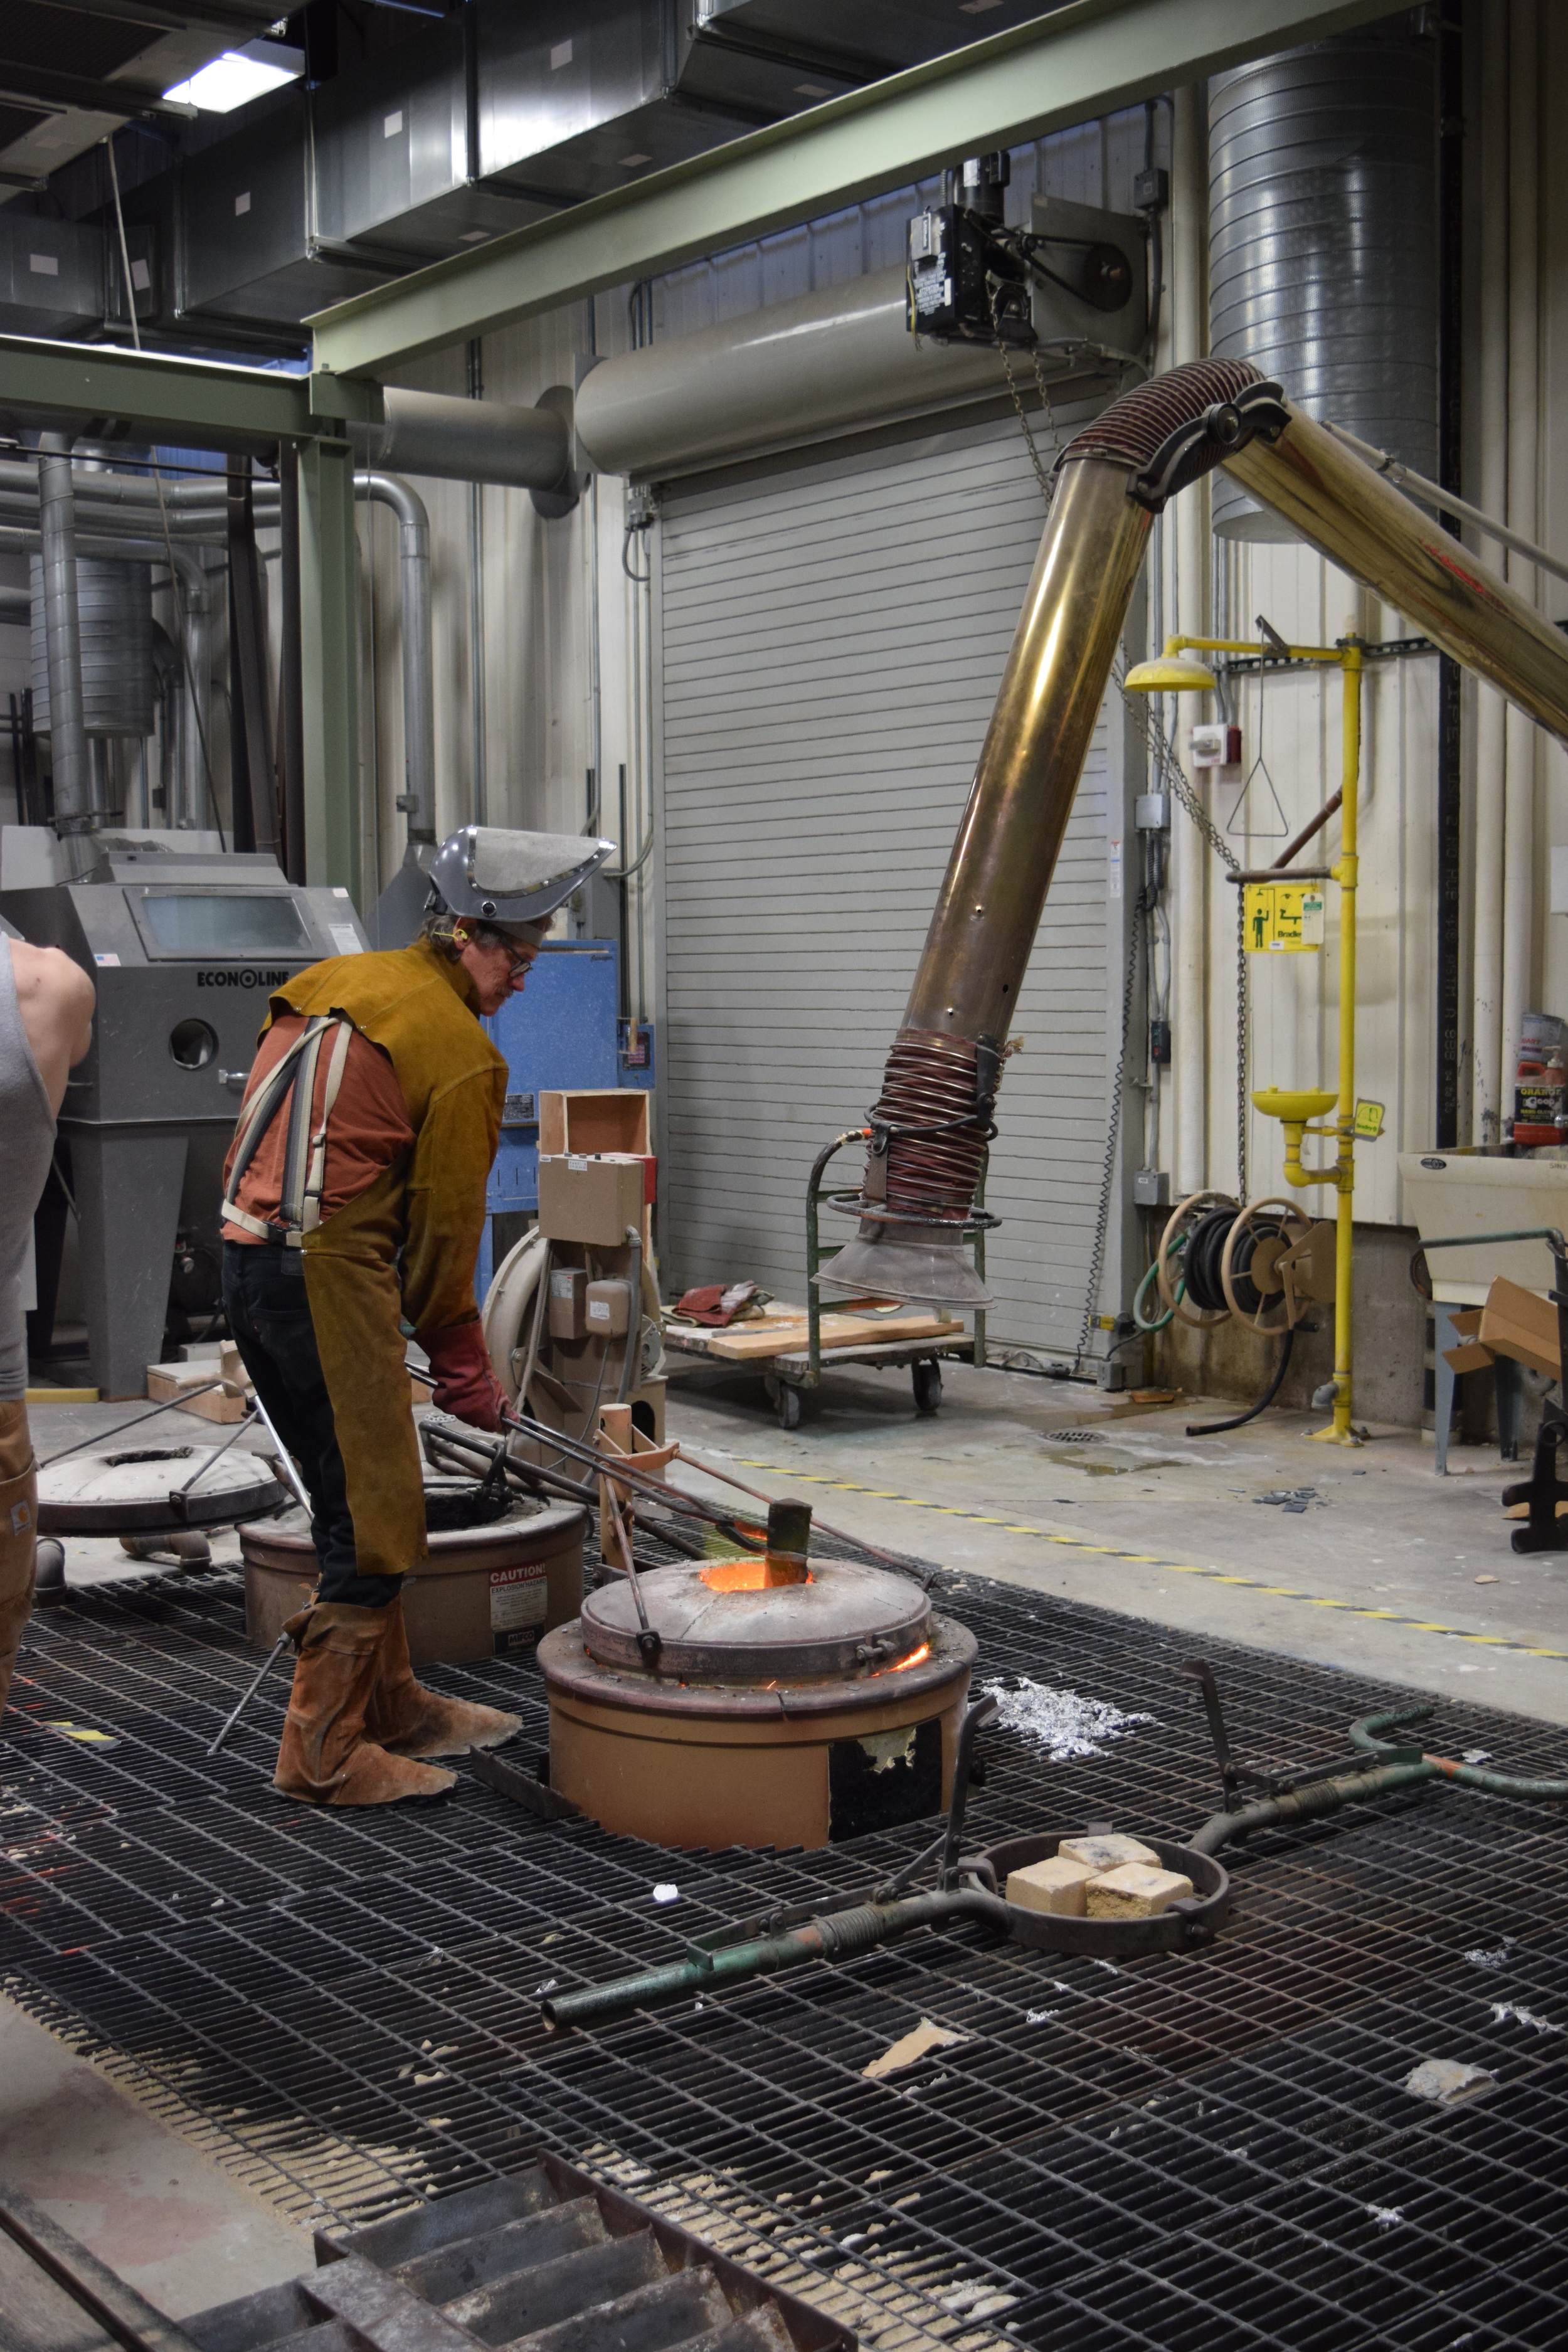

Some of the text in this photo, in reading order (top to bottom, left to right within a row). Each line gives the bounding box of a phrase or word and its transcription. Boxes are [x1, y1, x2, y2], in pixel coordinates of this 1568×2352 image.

[490, 1562, 546, 1584] CAUTION!
[491, 1578, 546, 1594] EXPLOSION HAZARD
[509, 1631, 534, 1644] MIFCO
